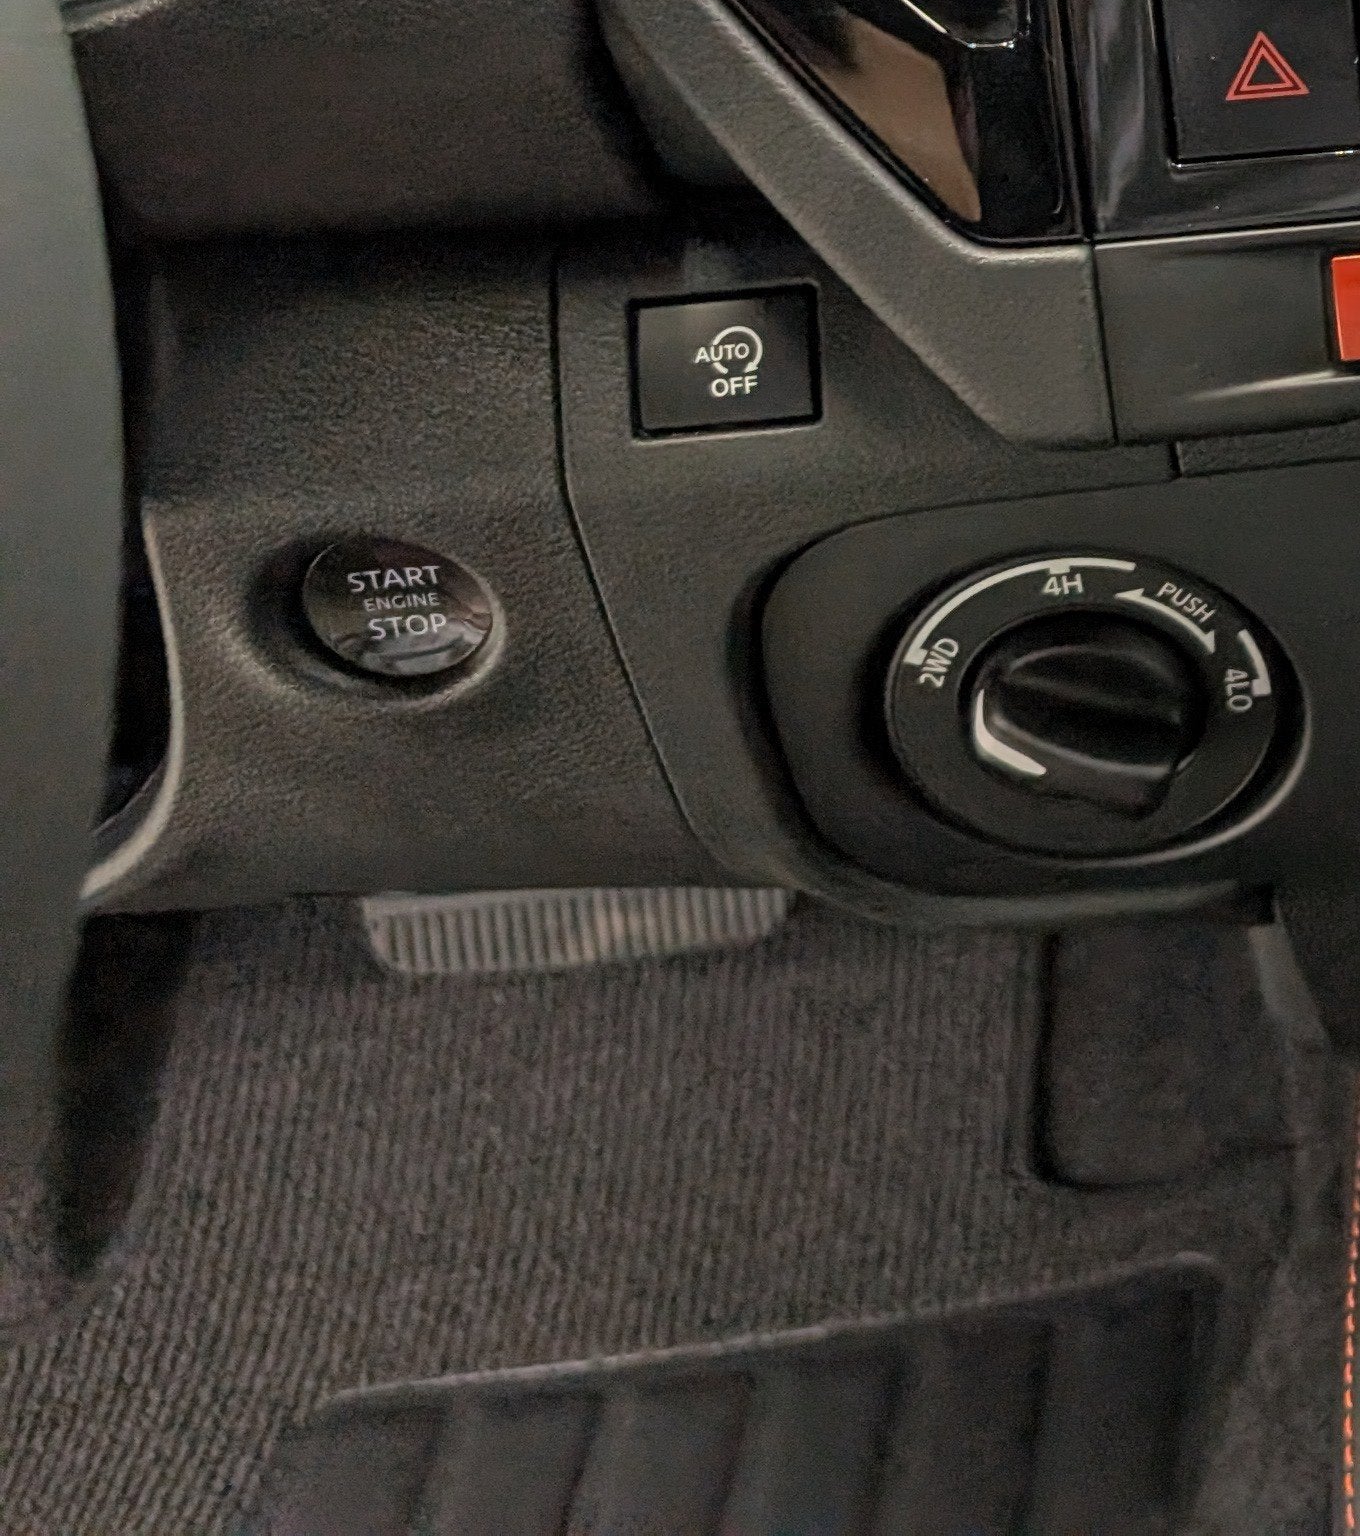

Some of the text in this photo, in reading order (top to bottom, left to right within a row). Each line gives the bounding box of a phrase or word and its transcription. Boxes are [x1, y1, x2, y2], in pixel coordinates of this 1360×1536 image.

[694, 342, 750, 365] AUTO
[711, 375, 758, 398] OFF
[347, 565, 441, 594] START
[1041, 573, 1084, 597] 4H
[363, 592, 441, 612] ENGINE
[1156, 581, 1217, 623] PUSH
[368, 613, 448, 640] STOP
[919, 637, 960, 689] 2WD
[1224, 667, 1253, 713] 4LO
